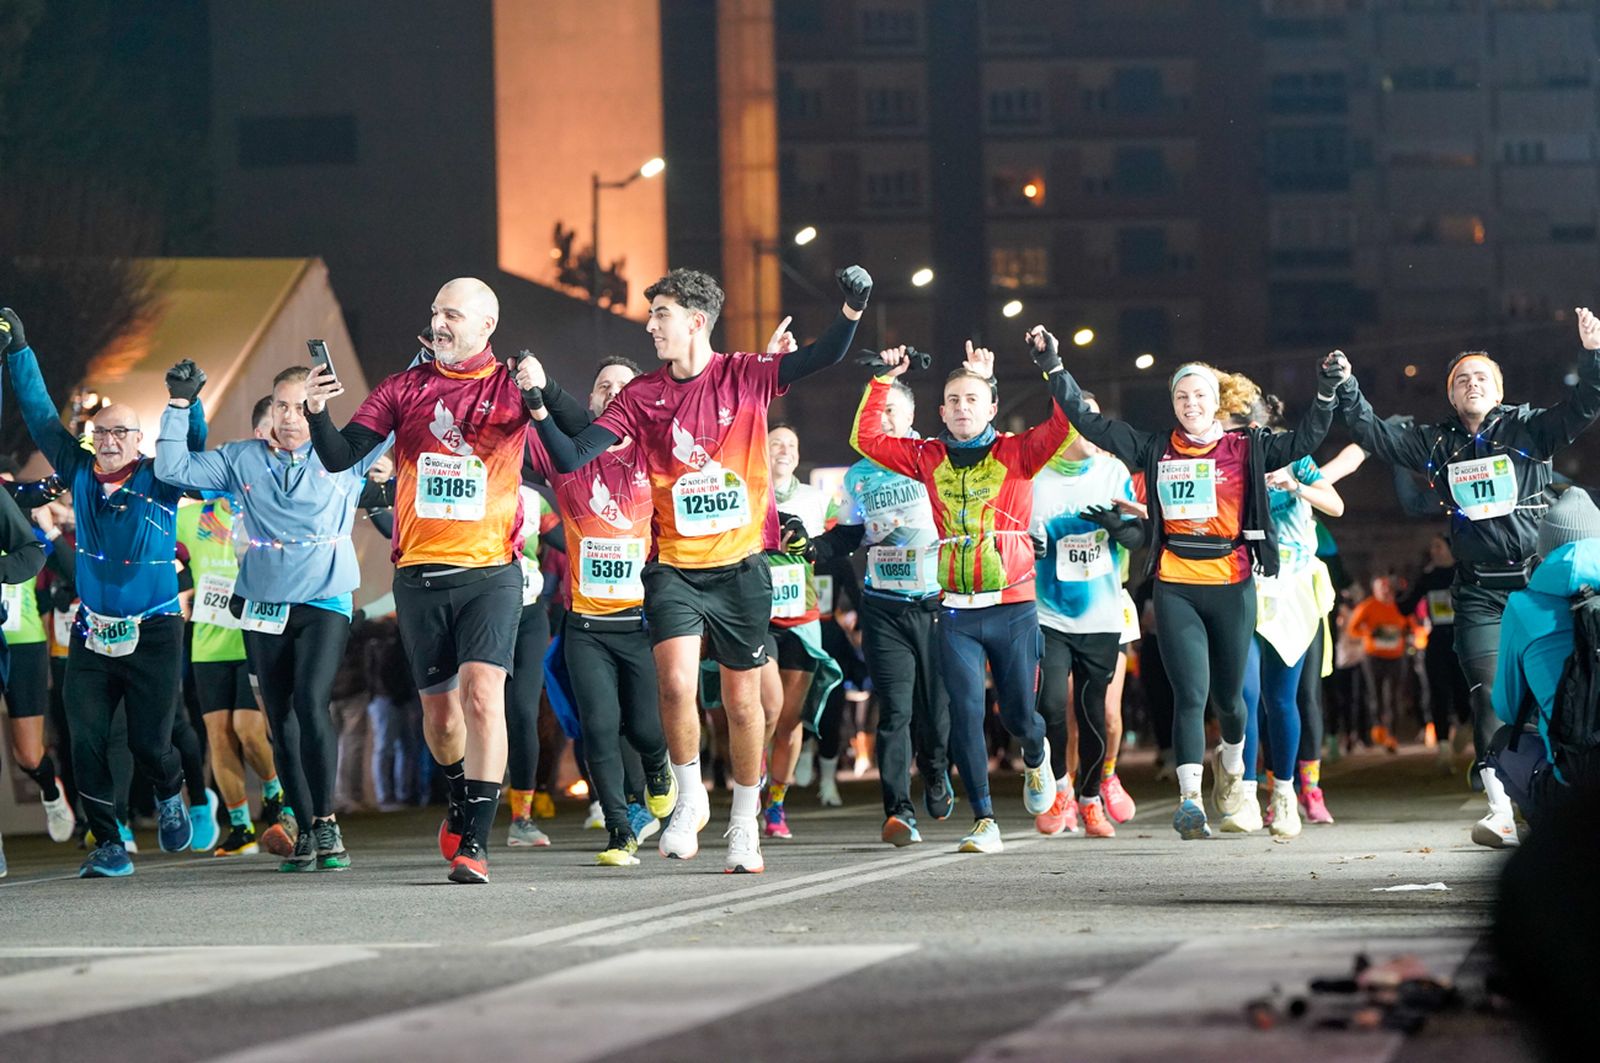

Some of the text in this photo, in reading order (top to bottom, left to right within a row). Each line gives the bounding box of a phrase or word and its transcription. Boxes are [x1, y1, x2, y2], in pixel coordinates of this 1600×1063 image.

[442, 430, 460, 448] 43
[689, 451, 707, 468] 43
[427, 477, 476, 498] 13185
[1170, 481, 1195, 499] 172
[1471, 480, 1495, 499] 171
[683, 490, 740, 514] 12562
[601, 505, 618, 521] 43
[1069, 545, 1101, 563] 6462
[592, 560, 633, 578] 5387
[204, 592, 229, 609] 629
[773, 584, 799, 601] 090
